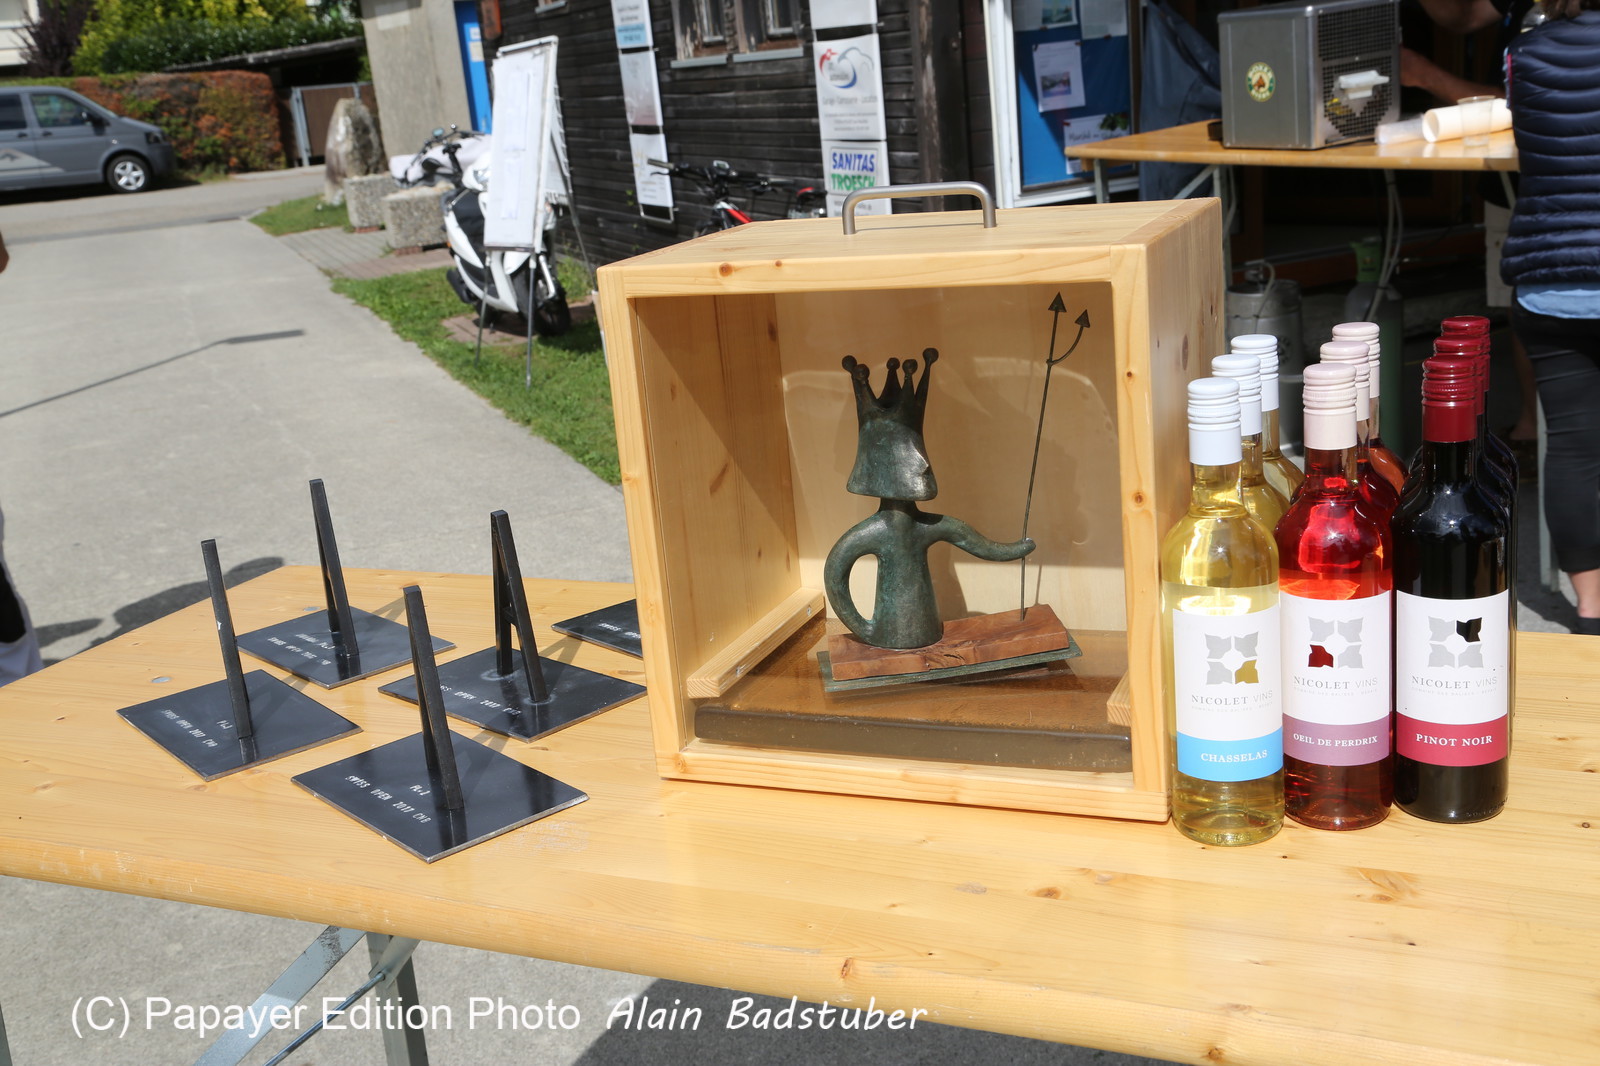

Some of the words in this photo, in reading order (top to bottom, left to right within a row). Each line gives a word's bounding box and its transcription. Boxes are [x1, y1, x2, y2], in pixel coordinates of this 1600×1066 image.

[832, 152, 875, 172] SANITAS
[1294, 676, 1350, 689] NICOLET
[1355, 677, 1378, 688] VINS
[1412, 676, 1470, 689] NICOLET
[1475, 676, 1497, 688] VINS
[1192, 694, 1248, 706] NICOLET
[1253, 690, 1272, 702] VINS
[1294, 733, 1315, 744] OEIL
[1318, 738, 1332, 747] DE
[1334, 736, 1378, 747] PERDRIX
[1416, 733, 1458, 746] PINOT
[1462, 736, 1493, 746] NOIR
[1200, 750, 1268, 763] CHASSELAS
[370, 788, 393, 801] OPEN
[392, 801, 415, 813] 2017
